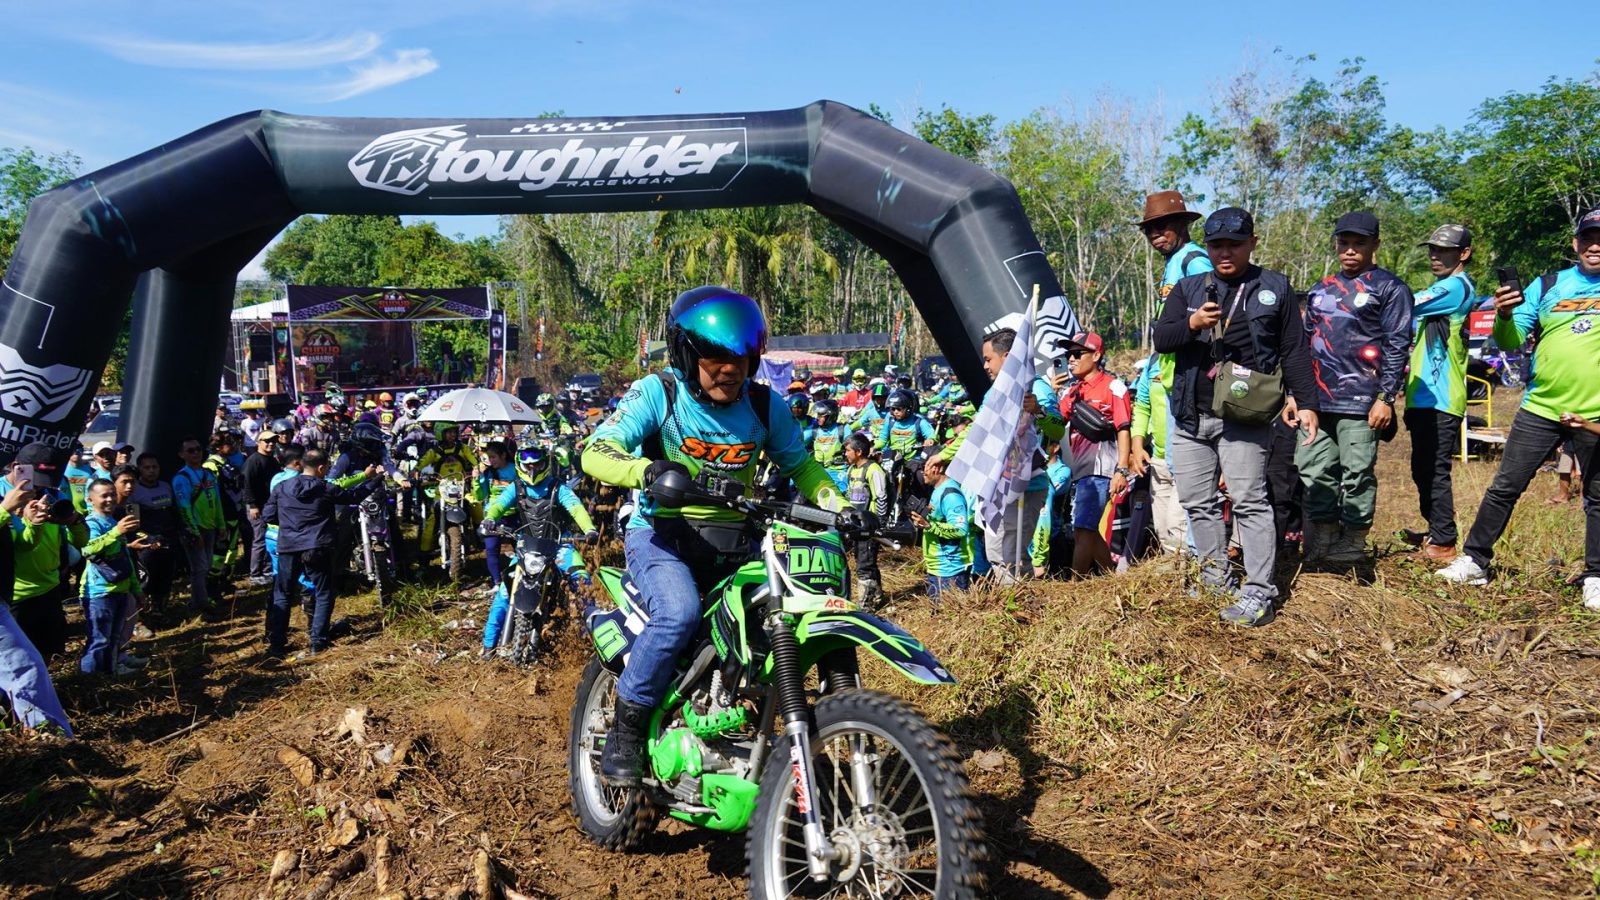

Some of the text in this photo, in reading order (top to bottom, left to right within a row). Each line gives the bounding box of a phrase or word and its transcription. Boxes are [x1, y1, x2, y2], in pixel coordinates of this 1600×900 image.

[427, 134, 739, 191] toughrider
[566, 177, 675, 187] RACEWEAR
[679, 436, 757, 464] STC
